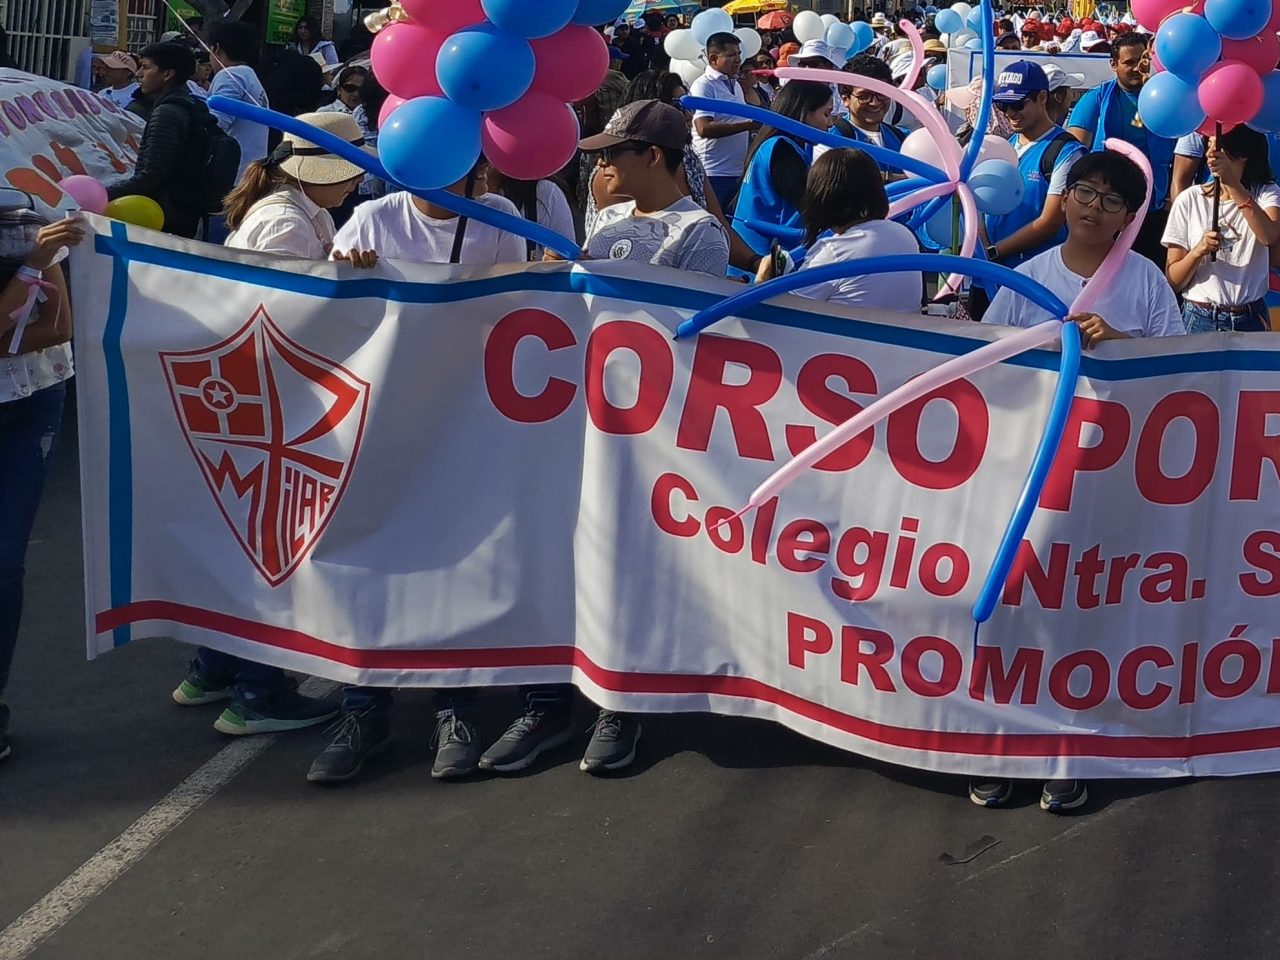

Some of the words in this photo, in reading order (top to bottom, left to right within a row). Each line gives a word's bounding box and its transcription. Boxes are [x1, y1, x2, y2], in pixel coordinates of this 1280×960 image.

[483, 306, 990, 491] CORSO
[650, 471, 970, 602] Colegio
[1001, 538, 1207, 611] Ntra.
